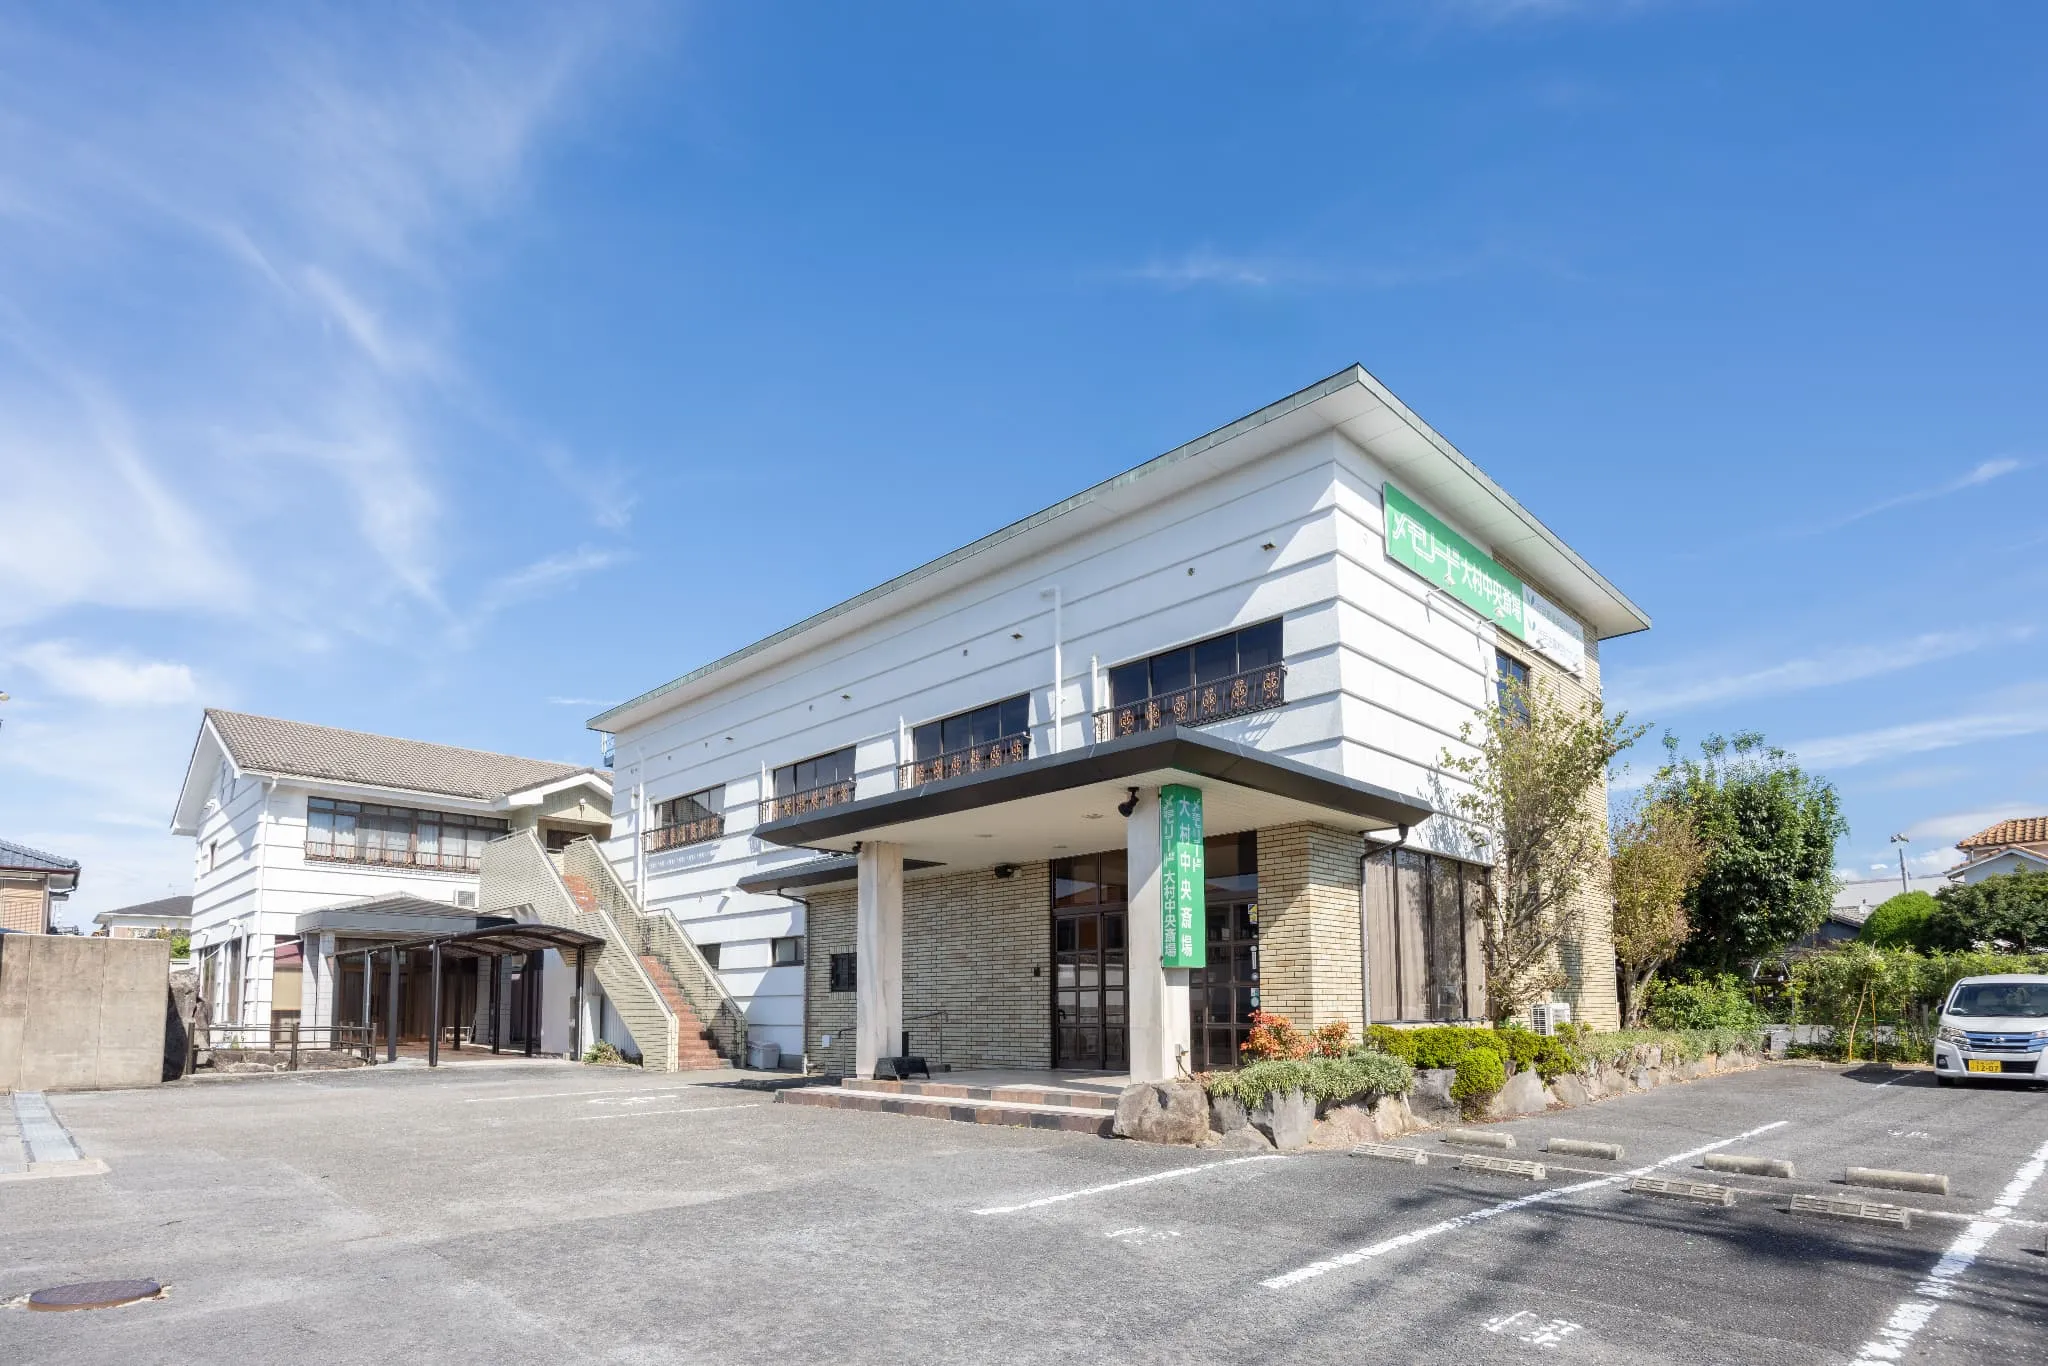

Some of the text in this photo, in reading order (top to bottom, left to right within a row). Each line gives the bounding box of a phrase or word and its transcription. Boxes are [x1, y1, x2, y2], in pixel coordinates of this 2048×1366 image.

[1164, 870, 1176, 957] 大村中央斎場
[1179, 795, 1192, 957] 大村中央斎場
